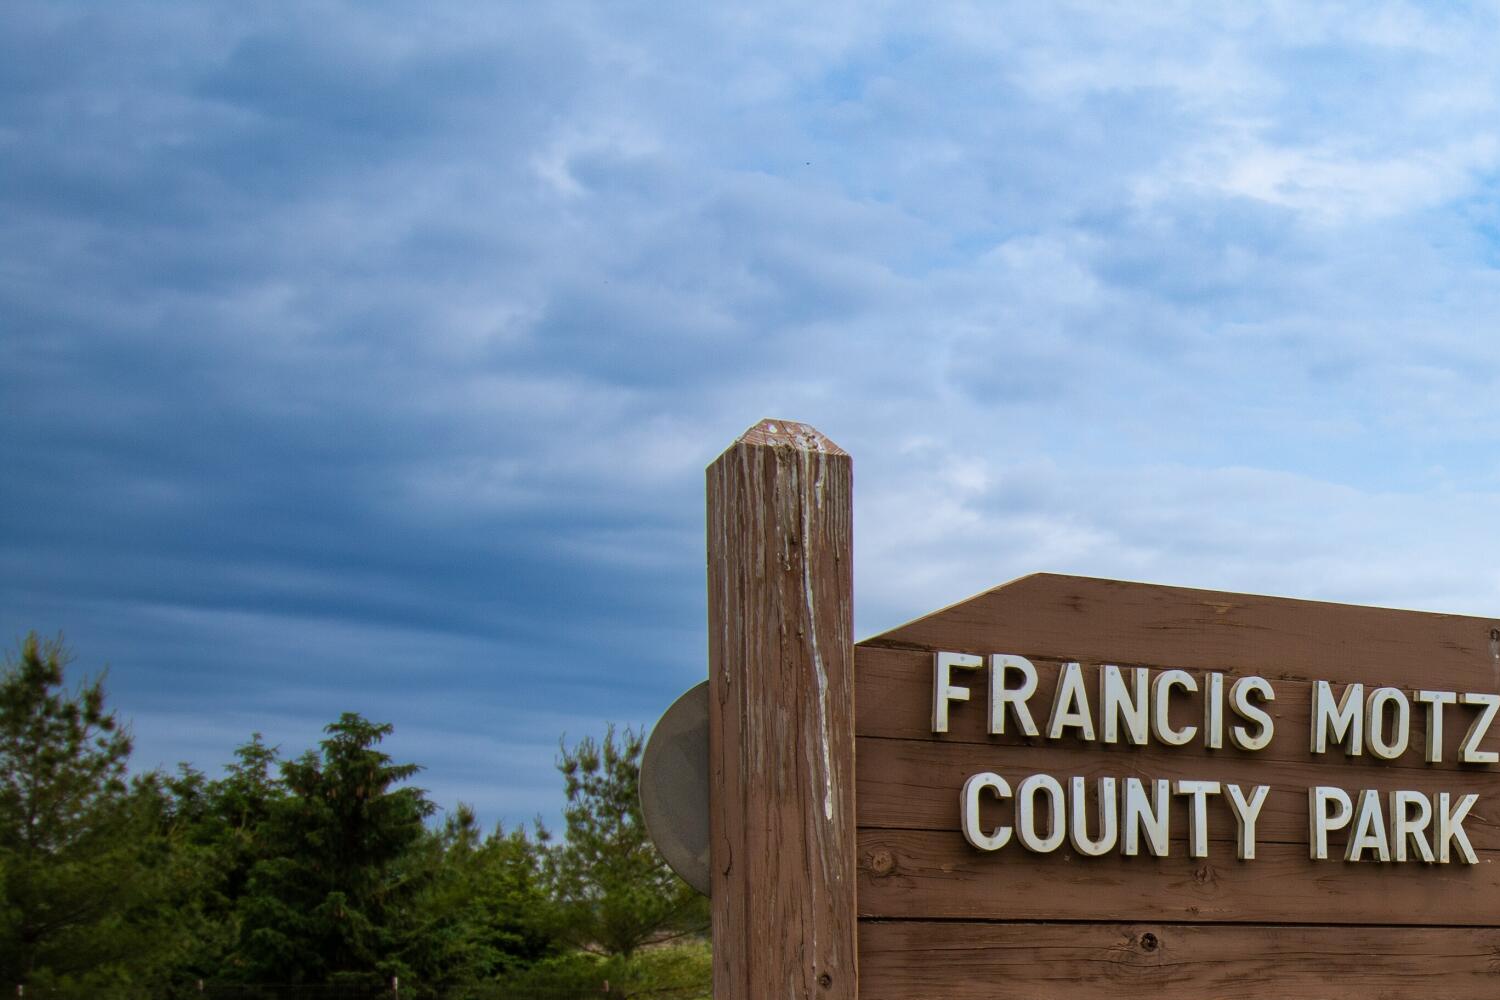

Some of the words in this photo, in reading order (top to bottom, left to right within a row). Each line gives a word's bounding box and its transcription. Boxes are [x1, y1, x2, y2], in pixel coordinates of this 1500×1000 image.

[931, 651, 1275, 751] FRANCIS
[1310, 680, 1500, 763] MOTZ
[961, 772, 1271, 860] COUNTY
[1308, 786, 1480, 864] PARK
